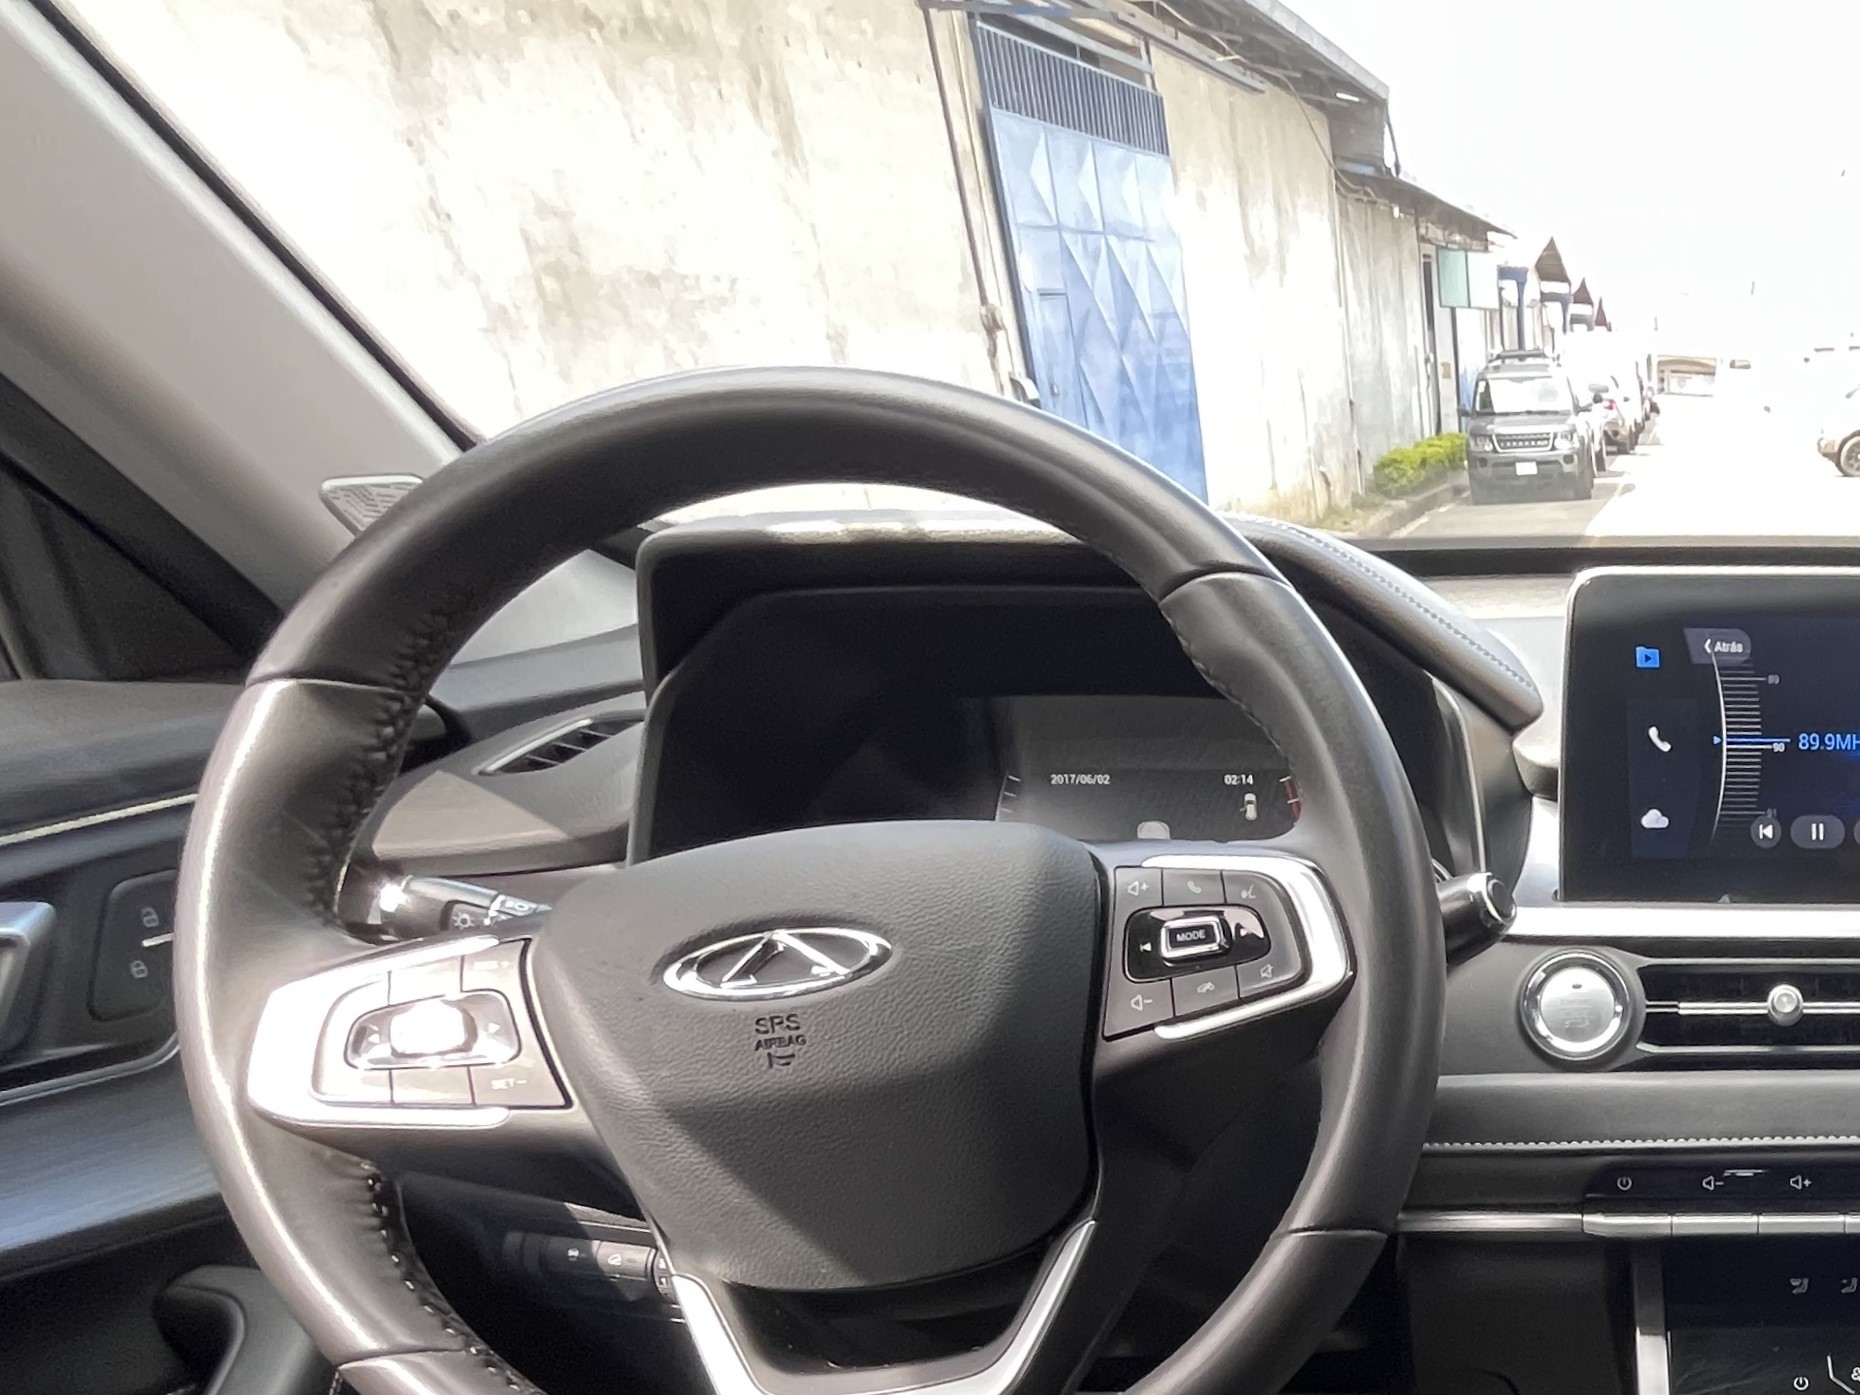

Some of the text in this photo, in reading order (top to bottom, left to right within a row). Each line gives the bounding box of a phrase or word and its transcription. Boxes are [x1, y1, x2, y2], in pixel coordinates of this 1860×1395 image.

[1714, 641, 1744, 653] Atrás
[1224, 774, 1254, 785] 02:14
[1176, 929, 1206, 942] MODE
